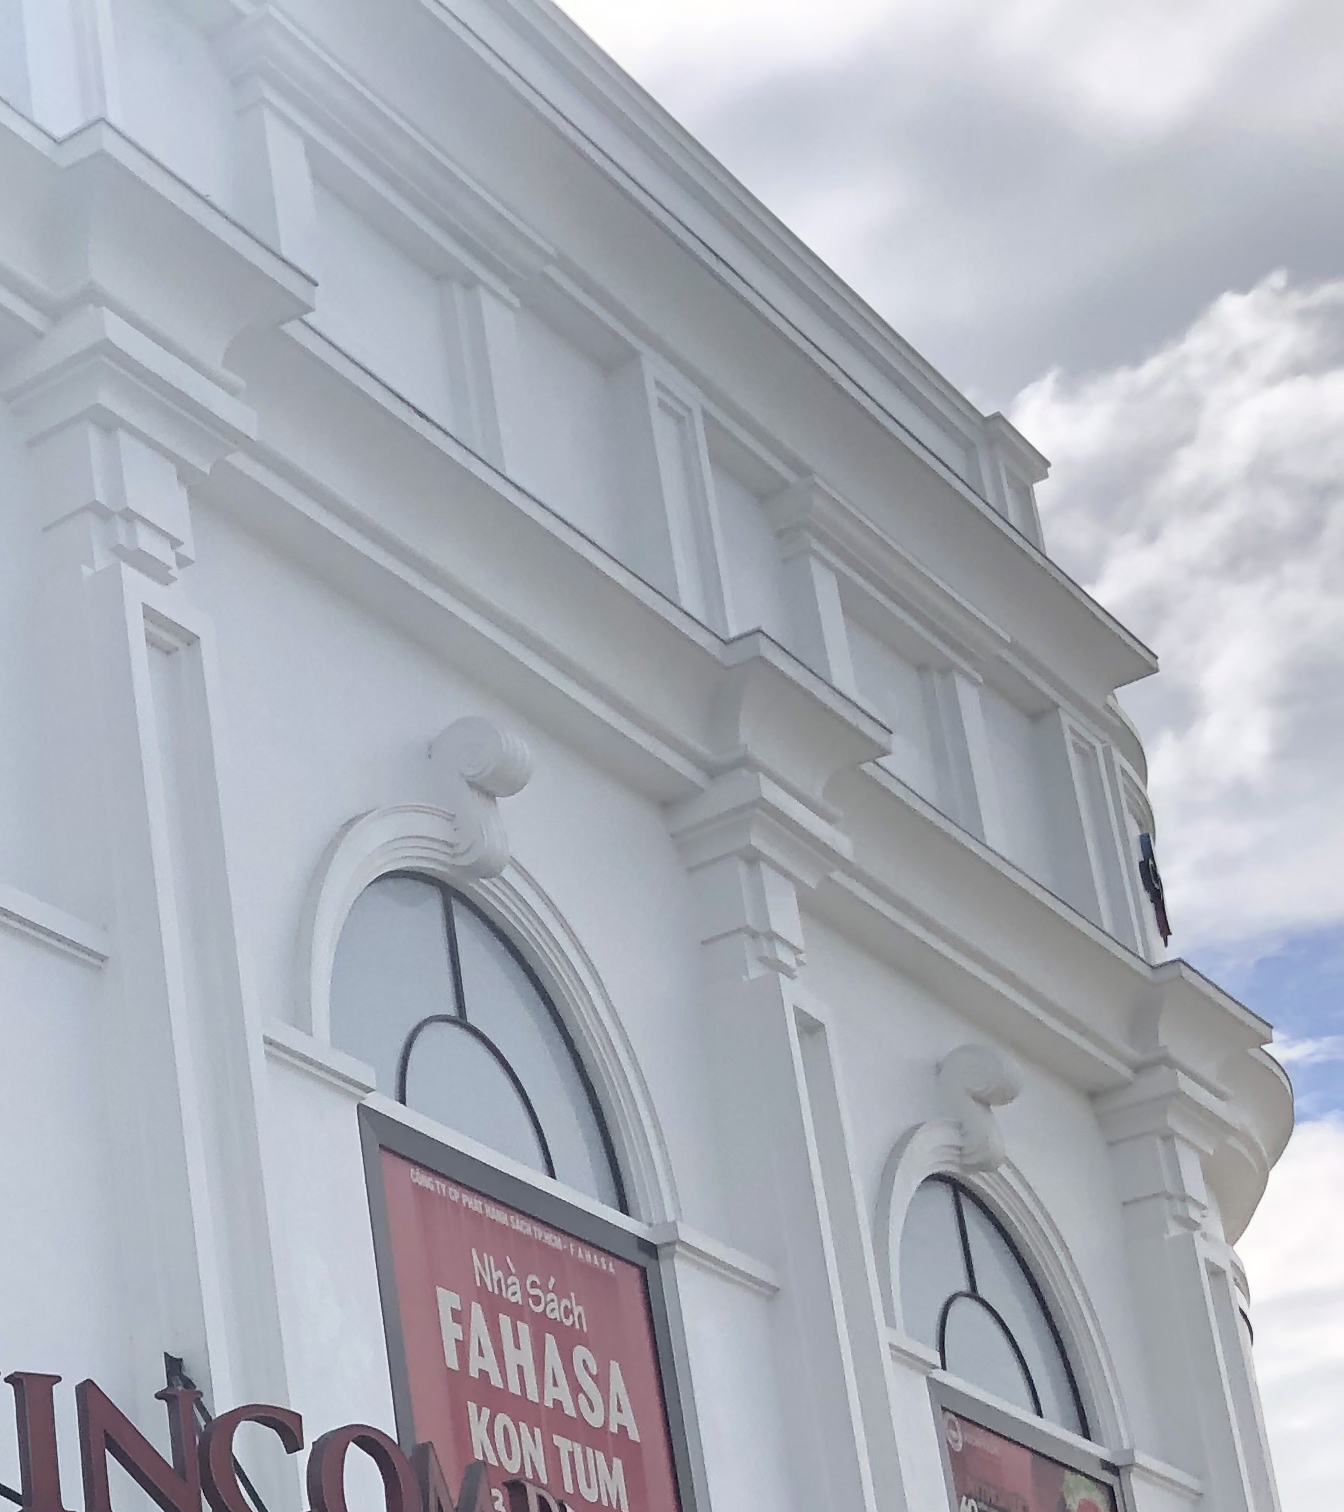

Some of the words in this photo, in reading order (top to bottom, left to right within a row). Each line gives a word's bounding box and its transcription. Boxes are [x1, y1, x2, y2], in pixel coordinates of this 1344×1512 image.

[471, 1247, 522, 1304] Nhà
[525, 1275, 588, 1332] Sách
[435, 1285, 641, 1443] FAHASA
[466, 1401, 548, 1485] KON
